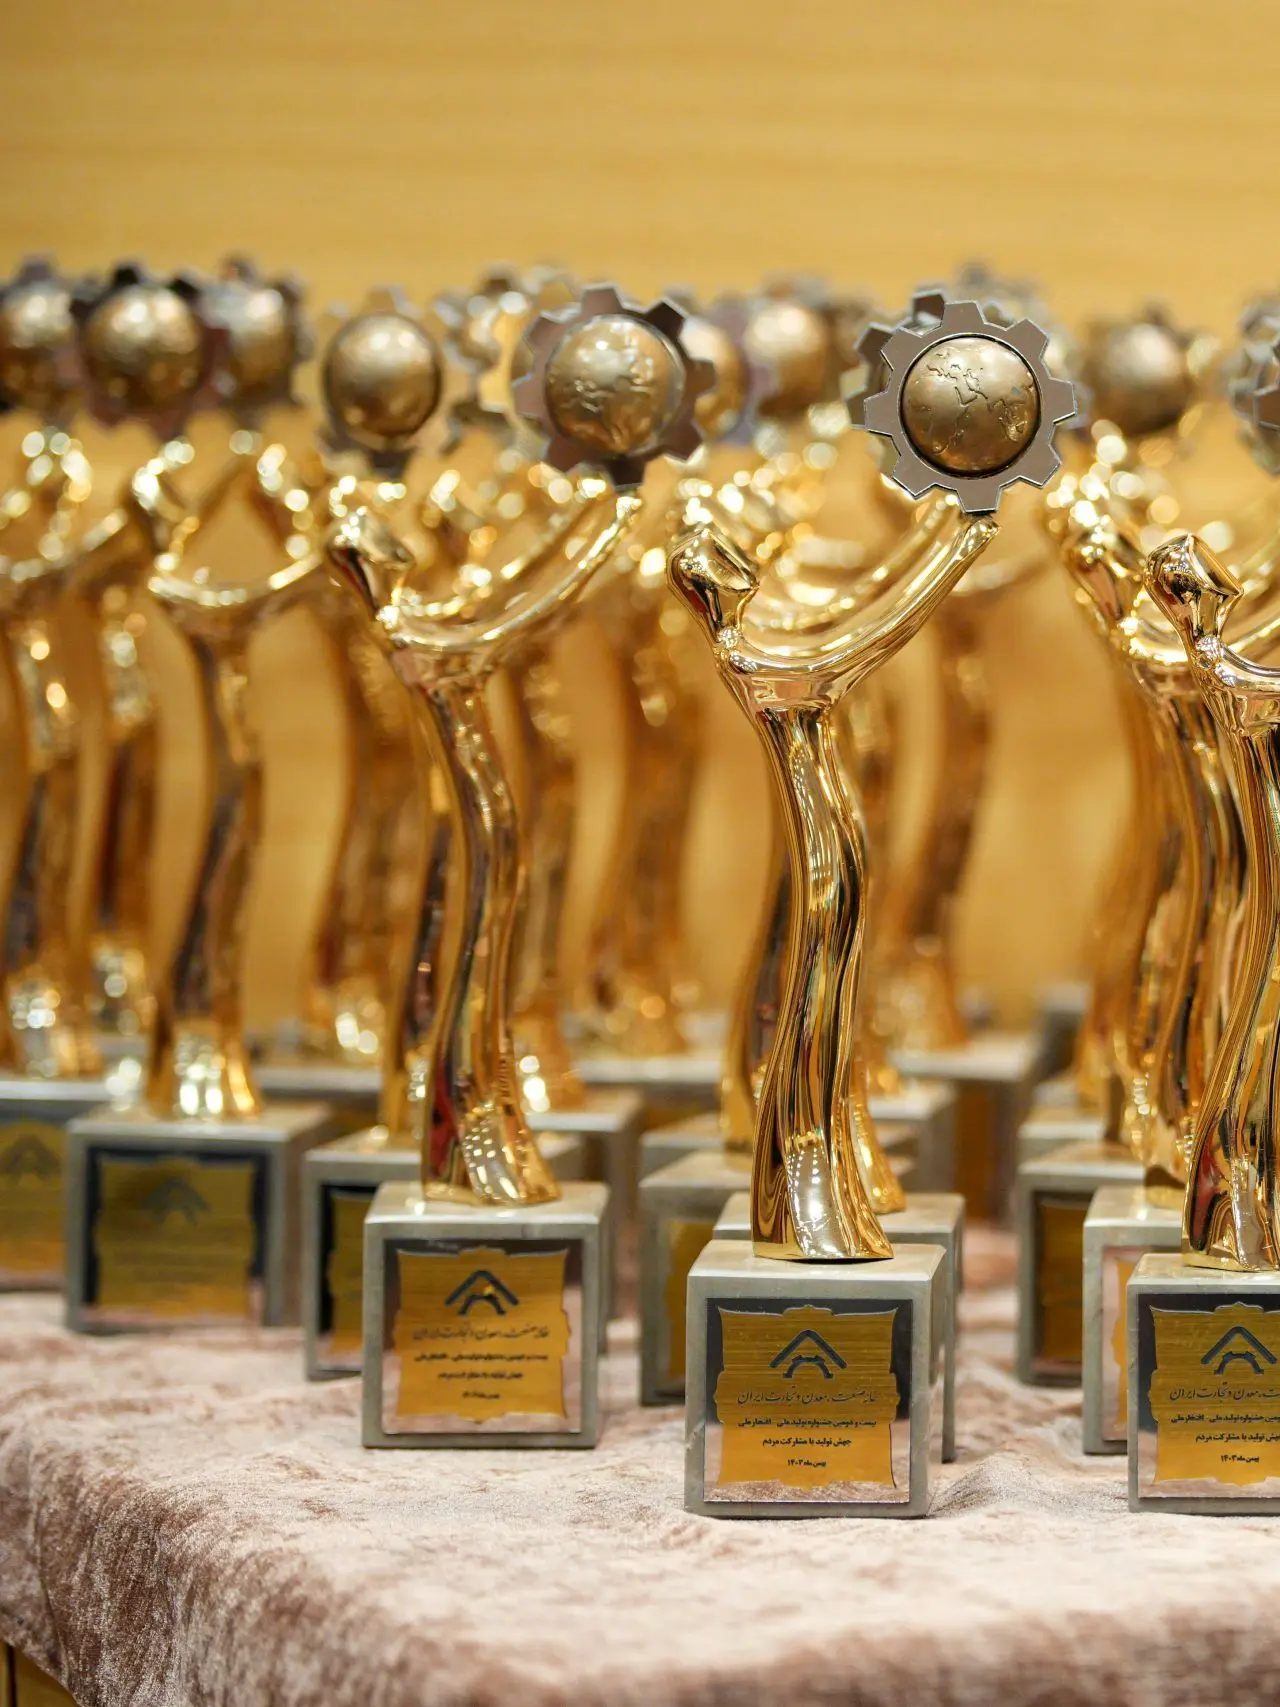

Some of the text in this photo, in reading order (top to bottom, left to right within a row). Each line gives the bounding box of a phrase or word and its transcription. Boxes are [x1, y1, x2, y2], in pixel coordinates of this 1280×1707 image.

[762, 1438, 780, 1447] مردم
[780, 1437, 808, 1447] مشارکت
[815, 1437, 832, 1447] تولید
[833, 1438, 851, 1447] جهش
[1195, 1434, 1212, 1443] مردم
[1212, 1433, 1240, 1443] مشارکت
[1248, 1433, 1265, 1443] تولید
